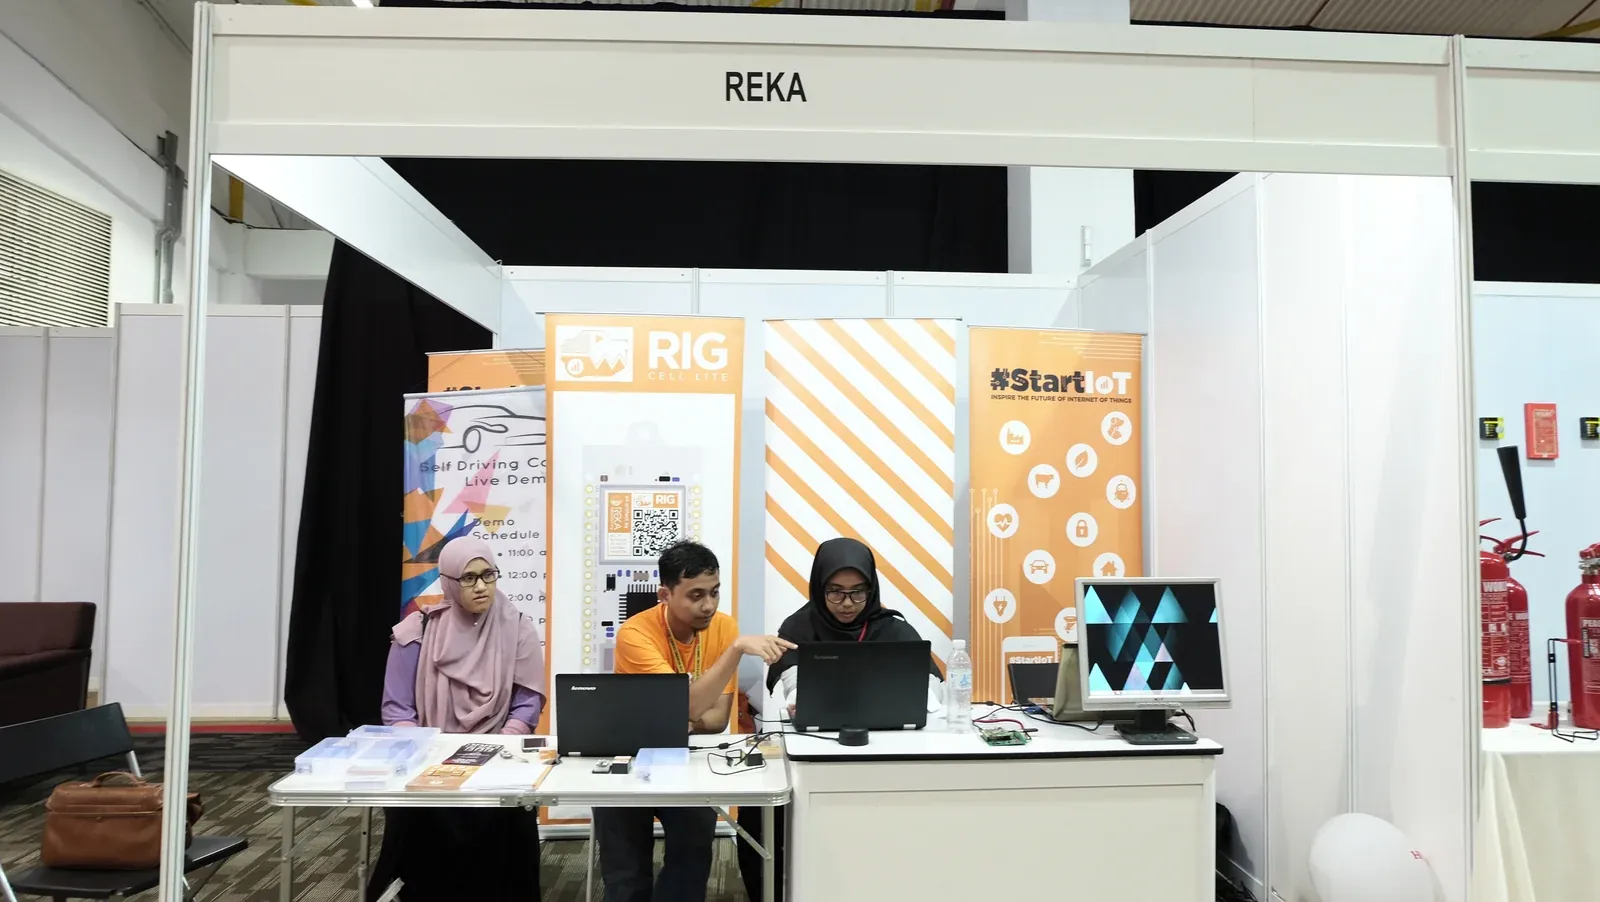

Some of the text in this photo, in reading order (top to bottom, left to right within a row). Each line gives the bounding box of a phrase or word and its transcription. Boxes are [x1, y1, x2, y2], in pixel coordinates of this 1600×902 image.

[725, 71, 807, 102] REKA
[648, 330, 728, 370] RIG
[648, 371, 729, 382] CELL LITE
[990, 368, 1131, 395] #StartIoT
[420, 457, 546, 472] Self Driving Ca
[465, 475, 546, 487] Live Dem
[655, 494, 676, 505] RIG
[473, 517, 515, 527] Demo
[472, 531, 539, 541] Schedule
[508, 549, 534, 557] 11:00
[508, 571, 538, 579] 12:00
[1009, 656, 1053, 664] #StartIoT
